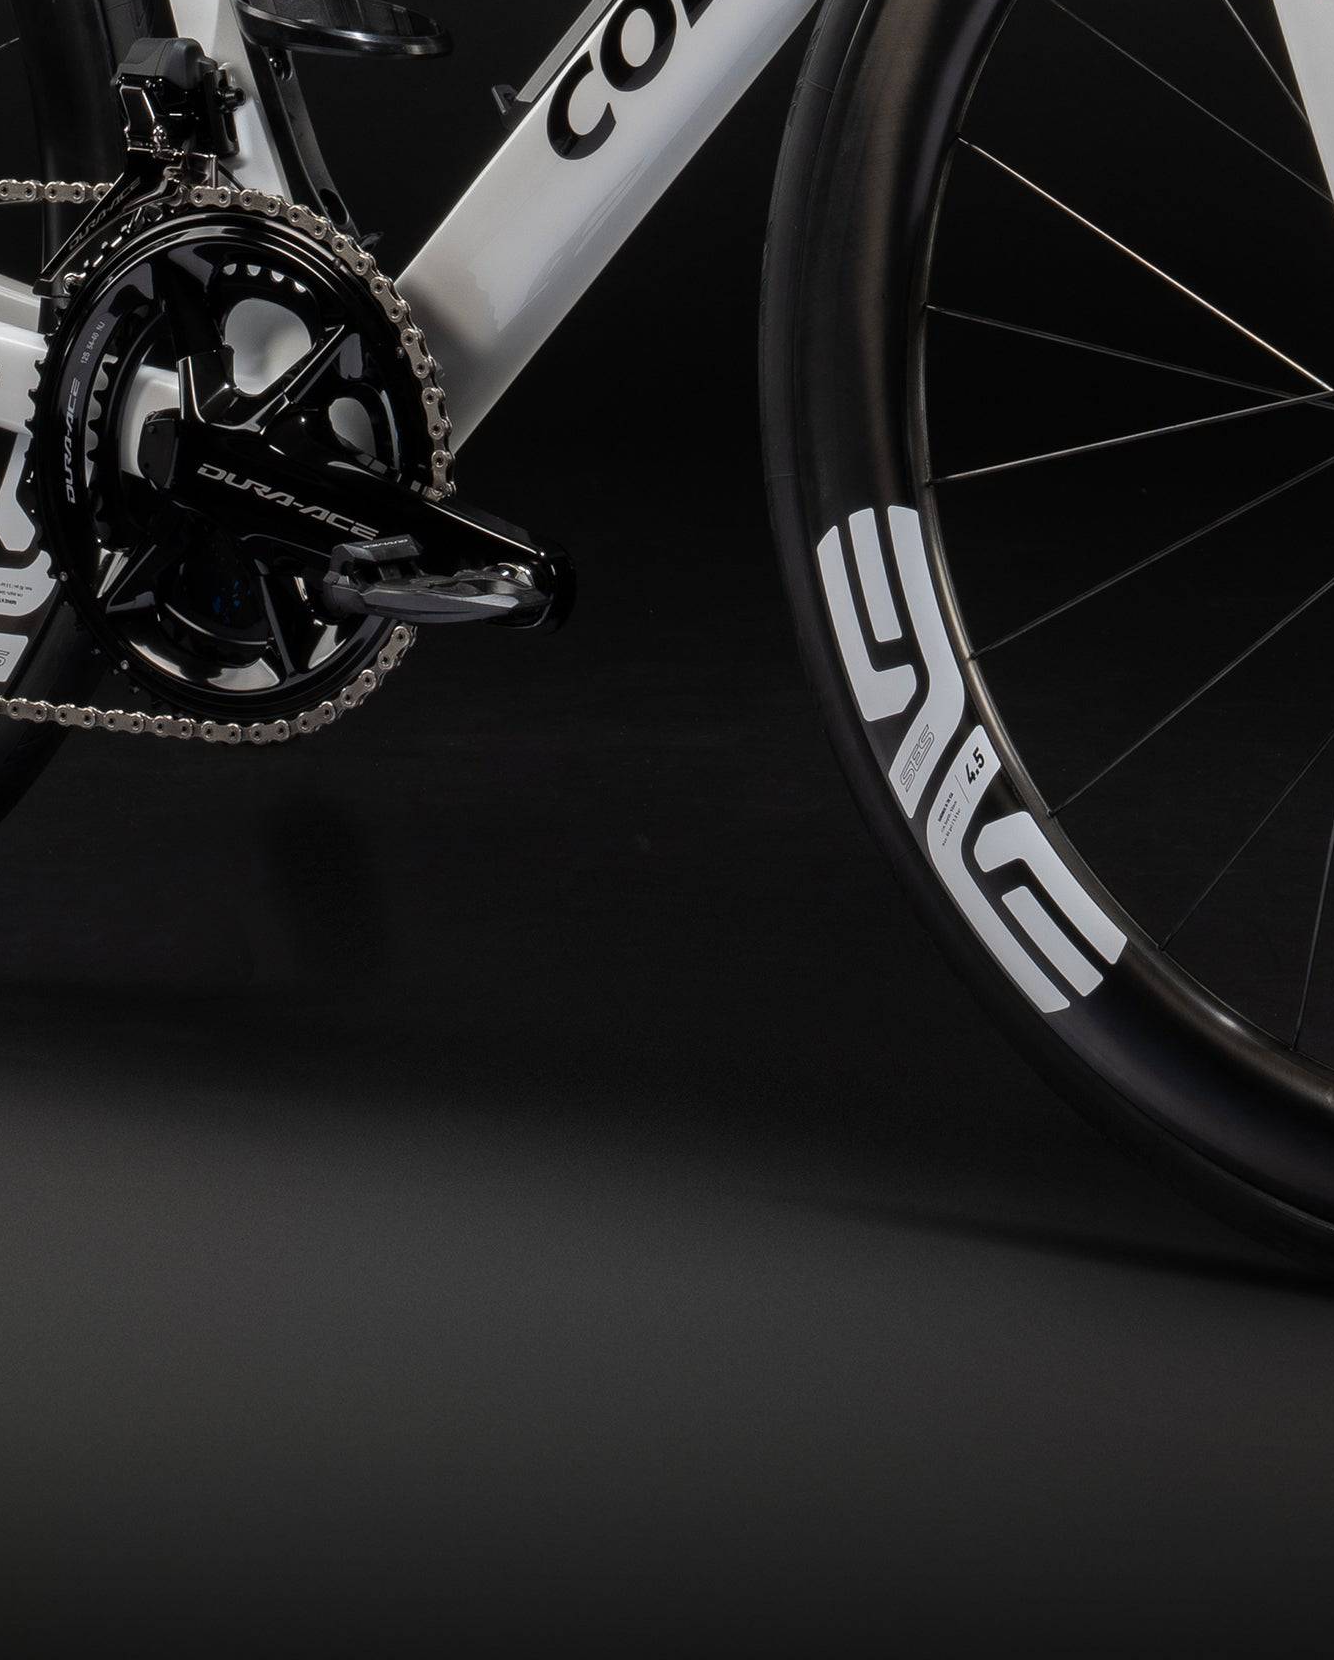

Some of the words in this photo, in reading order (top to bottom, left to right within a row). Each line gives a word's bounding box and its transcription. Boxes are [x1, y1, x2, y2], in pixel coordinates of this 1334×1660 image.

[64, 376, 81, 505] DURA-ACE
[196, 462, 380, 541] DURA-ACE
[965, 746, 986, 785] 4.5
